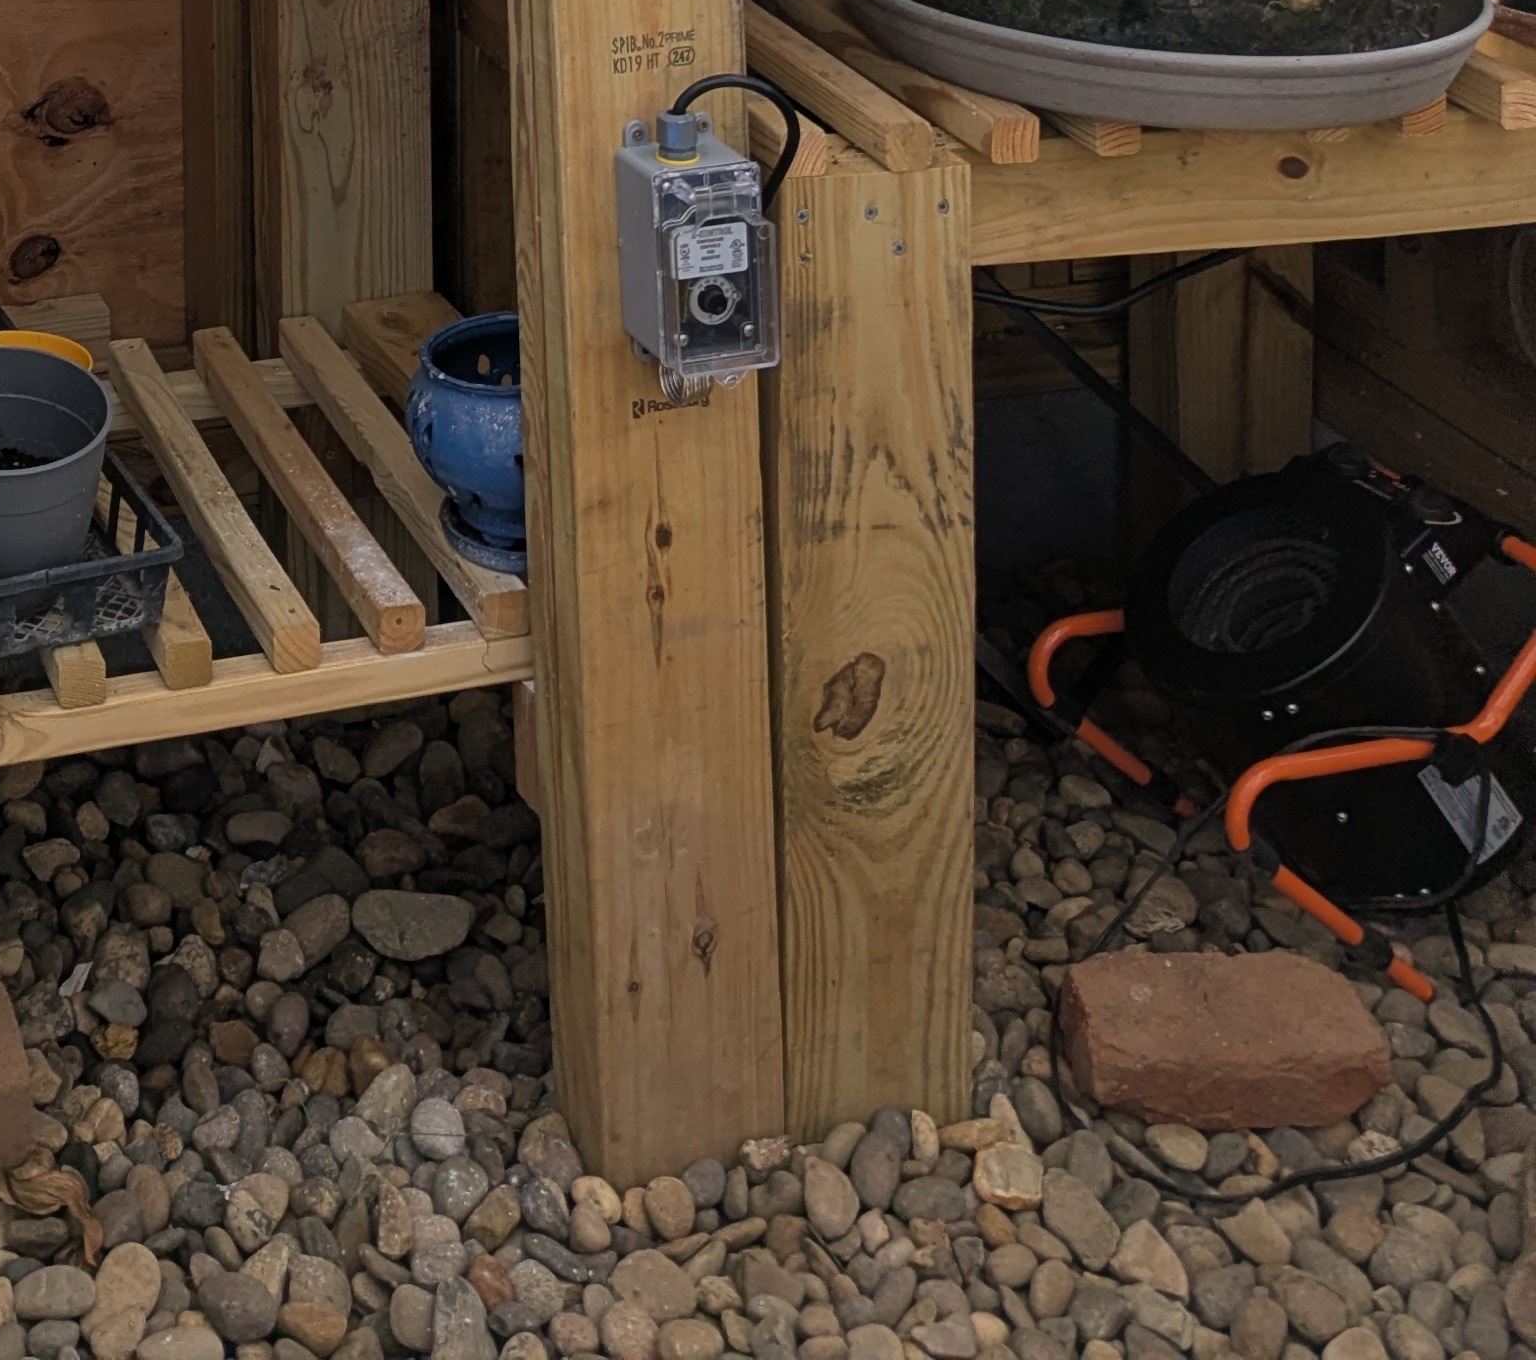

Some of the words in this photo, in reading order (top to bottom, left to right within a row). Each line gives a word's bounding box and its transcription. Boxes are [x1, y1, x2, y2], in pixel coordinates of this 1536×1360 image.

[612, 55, 642, 75] KD19
[646, 52, 660, 70] HT
[672, 49, 691, 64] 247
[1431, 541, 1457, 578] VEVOR
